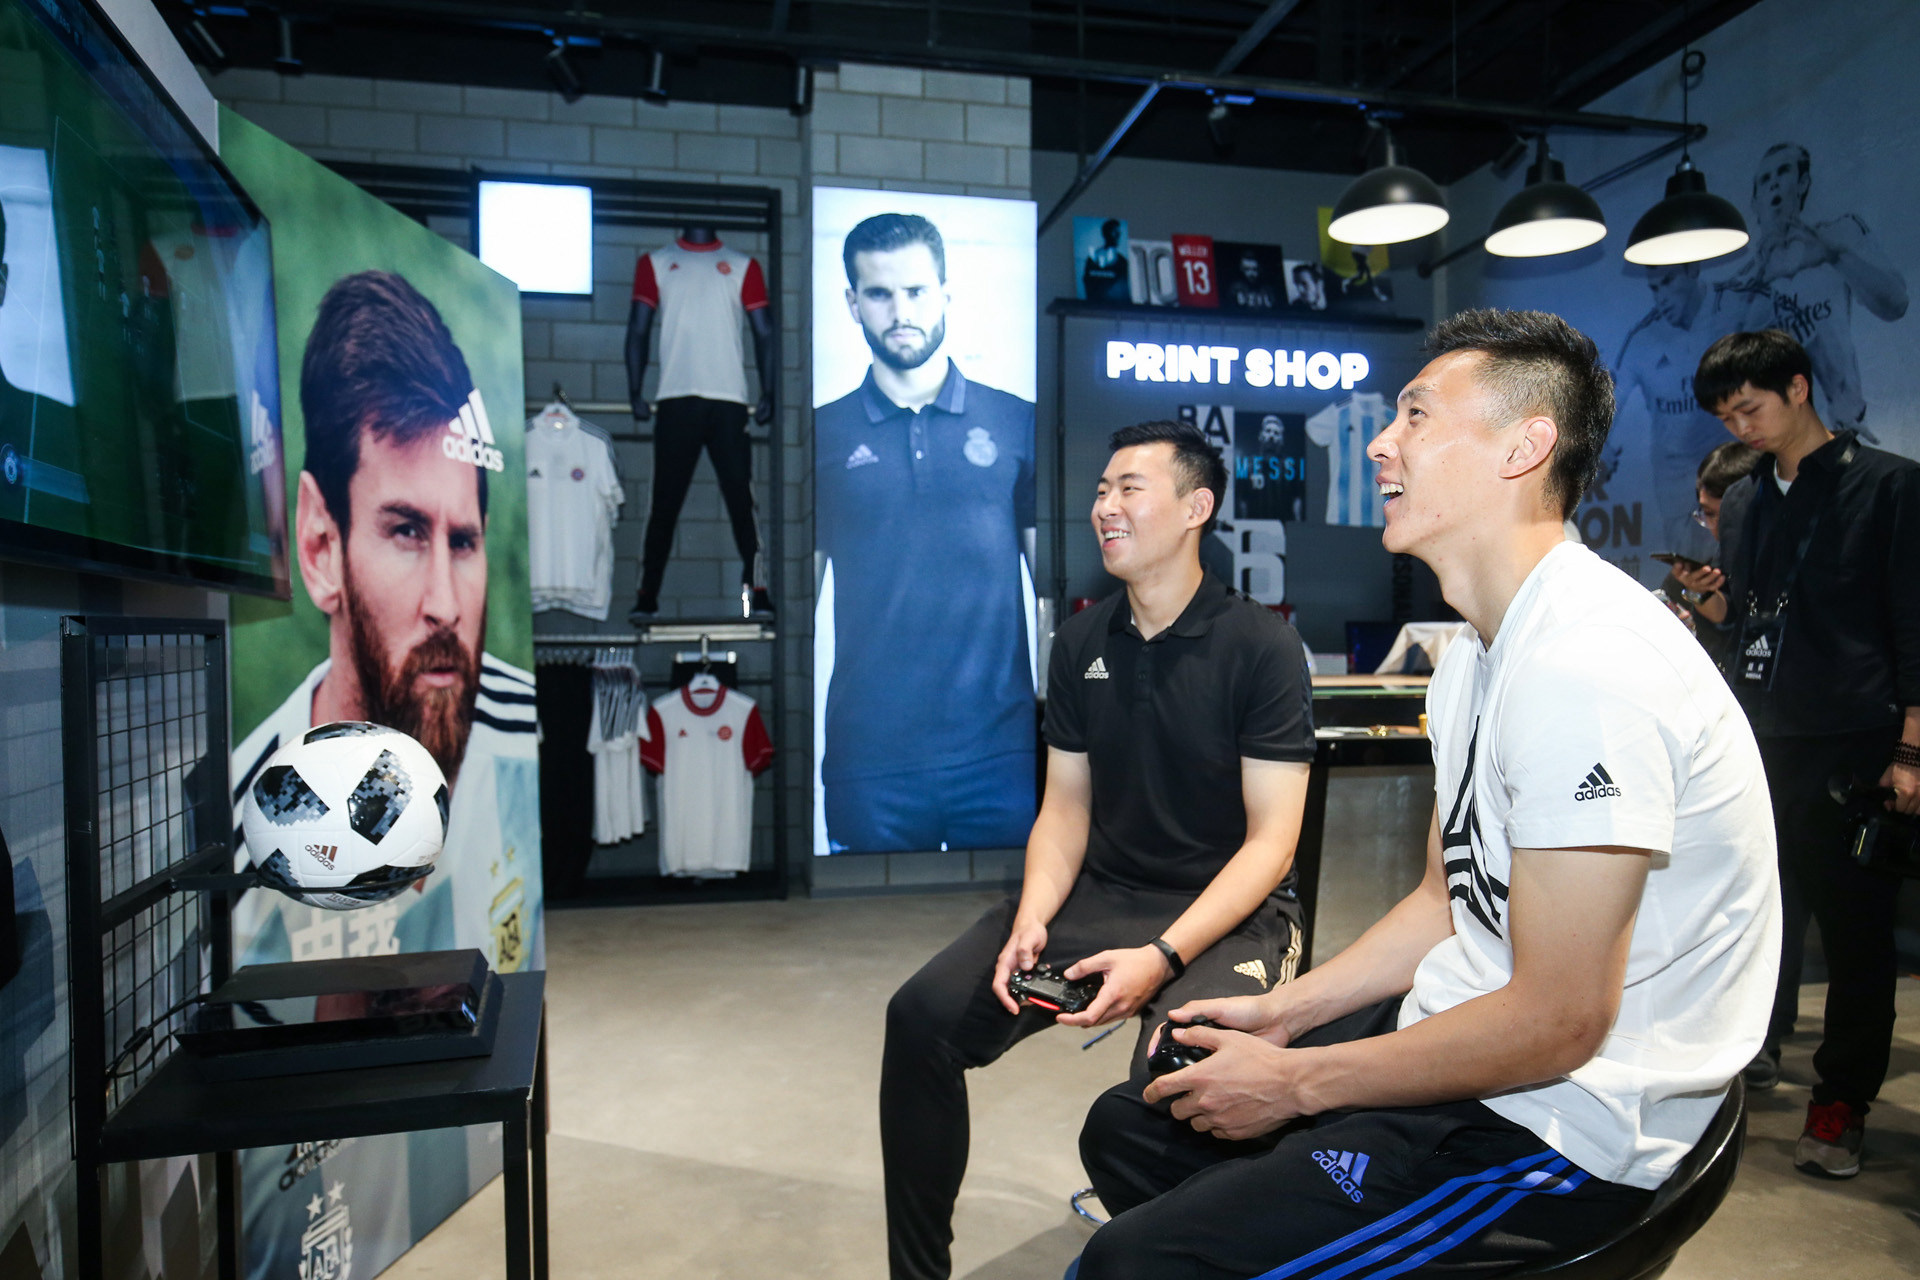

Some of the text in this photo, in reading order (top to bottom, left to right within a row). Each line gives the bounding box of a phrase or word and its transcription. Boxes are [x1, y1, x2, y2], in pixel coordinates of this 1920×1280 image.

[1183, 259, 1211, 295] 13
[1106, 340, 1370, 391] PRINT SHOP
[441, 435, 505, 472] adidas
[1235, 456, 1305, 482] MESSI
[1573, 501, 1643, 551] ON
[1745, 647, 1772, 658] adidas
[1084, 670, 1110, 680] adidas
[1574, 784, 1622, 802] adidas
[304, 843, 336, 872] adidas
[1233, 964, 1268, 990] adidas
[1311, 1150, 1364, 1204] adidas
